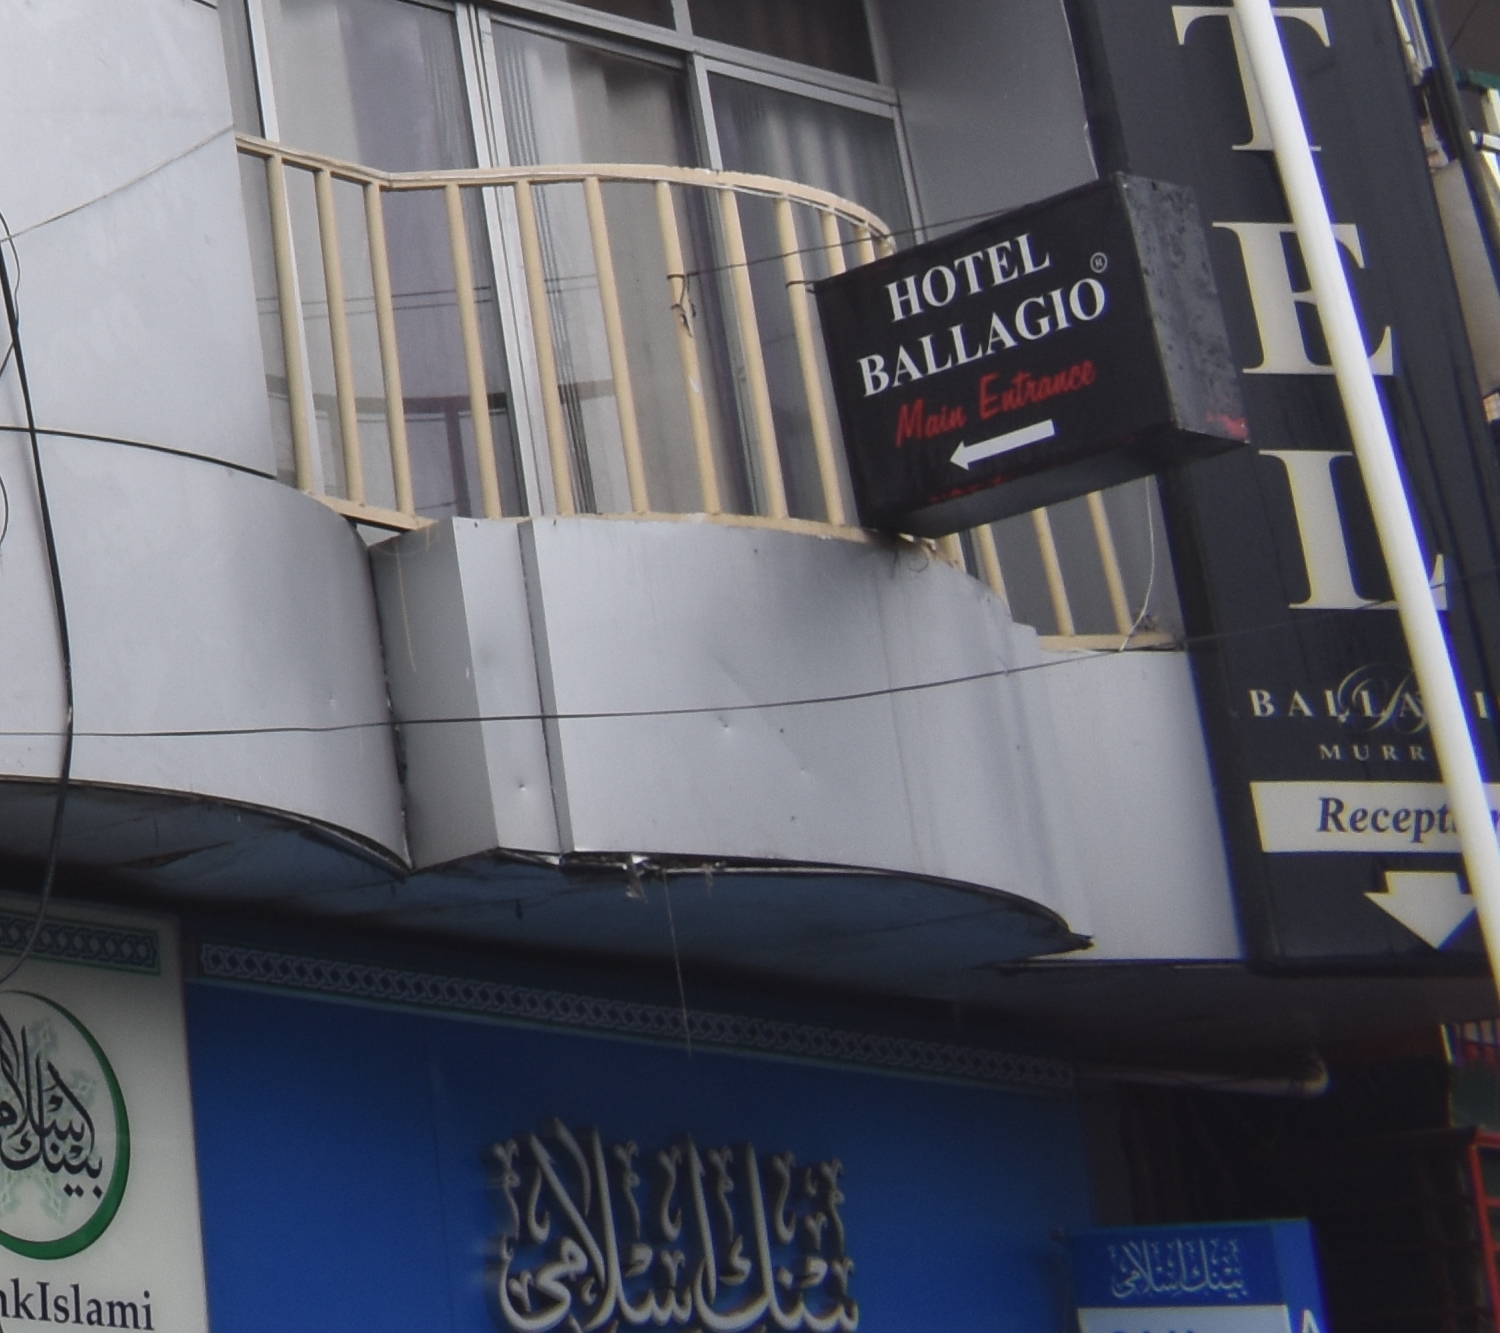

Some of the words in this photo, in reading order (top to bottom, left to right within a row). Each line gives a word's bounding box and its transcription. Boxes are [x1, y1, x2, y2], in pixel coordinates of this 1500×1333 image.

[885, 233, 1050, 323] HOTEL
[857, 277, 1108, 397] BALLAGIO
[896, 398, 967, 448] Main
[978, 359, 1097, 421] Entrance
